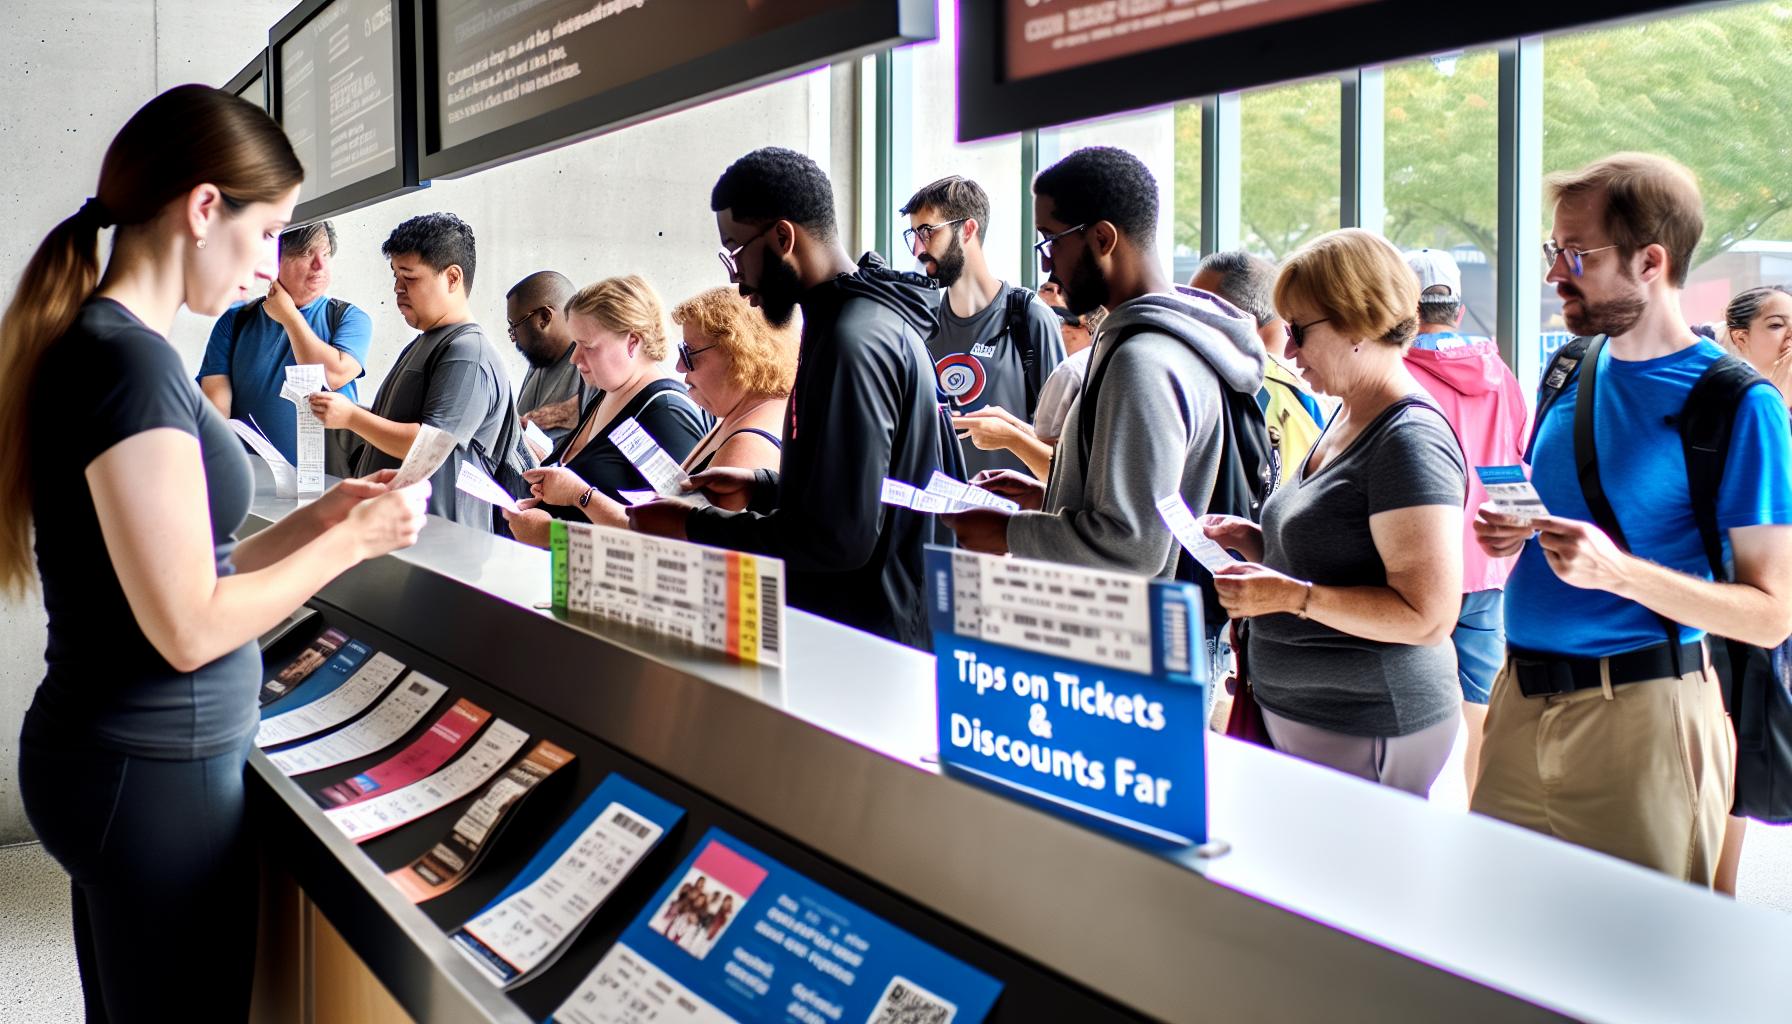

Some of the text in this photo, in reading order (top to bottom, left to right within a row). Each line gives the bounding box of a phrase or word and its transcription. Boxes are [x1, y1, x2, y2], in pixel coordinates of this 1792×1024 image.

[954, 650, 1165, 730] Tips on Tickets
[1029, 703, 1052, 738] &
[952, 714, 1171, 806] Discounts Far
